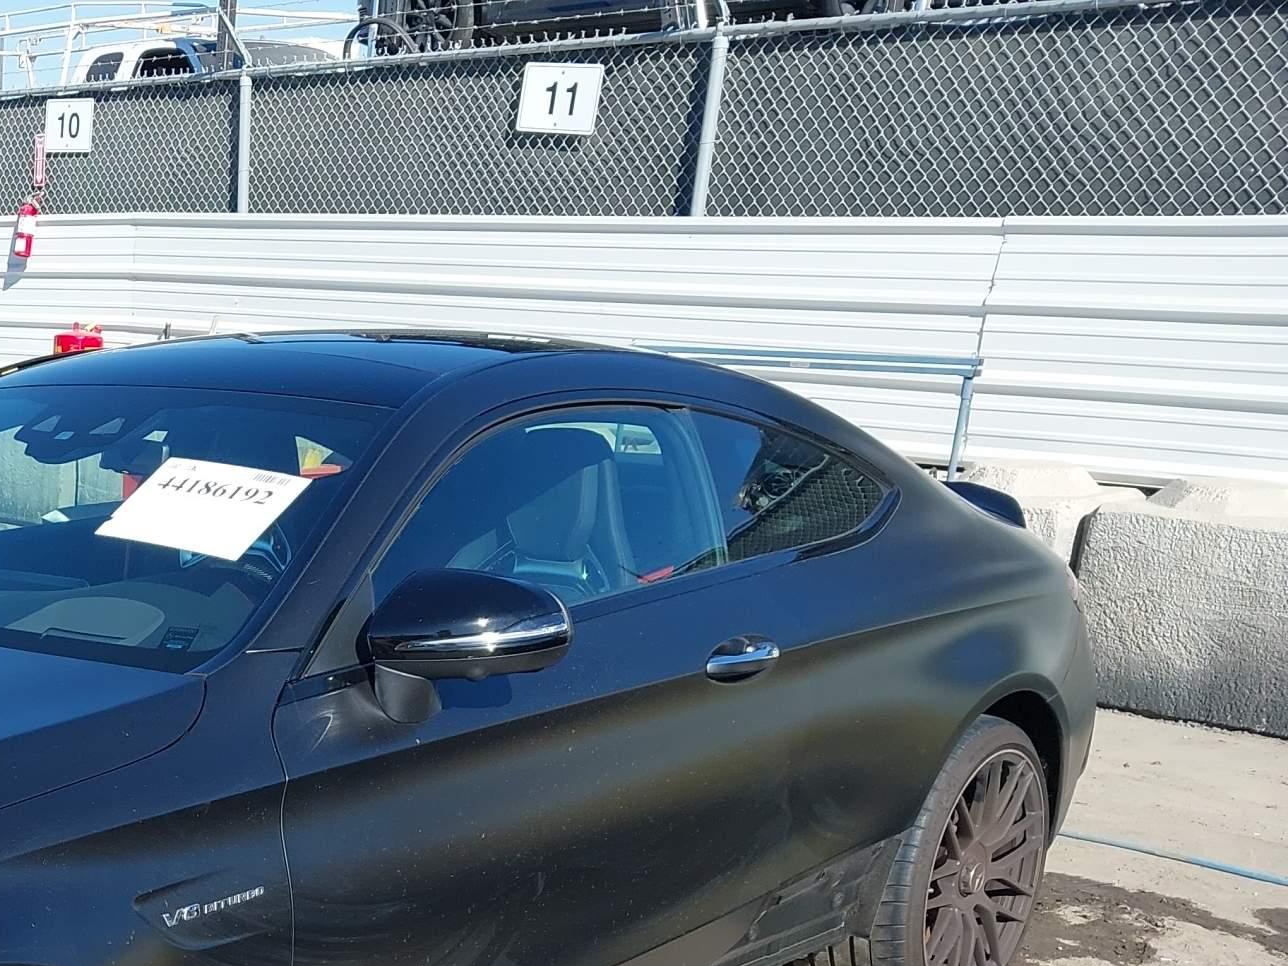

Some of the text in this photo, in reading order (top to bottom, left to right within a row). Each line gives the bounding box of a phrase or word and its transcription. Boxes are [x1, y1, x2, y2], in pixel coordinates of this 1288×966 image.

[546, 81, 578, 116] 11
[58, 112, 80, 138] 10
[157, 476, 273, 504] 44186192
[203, 886, 264, 914] BITURBO
